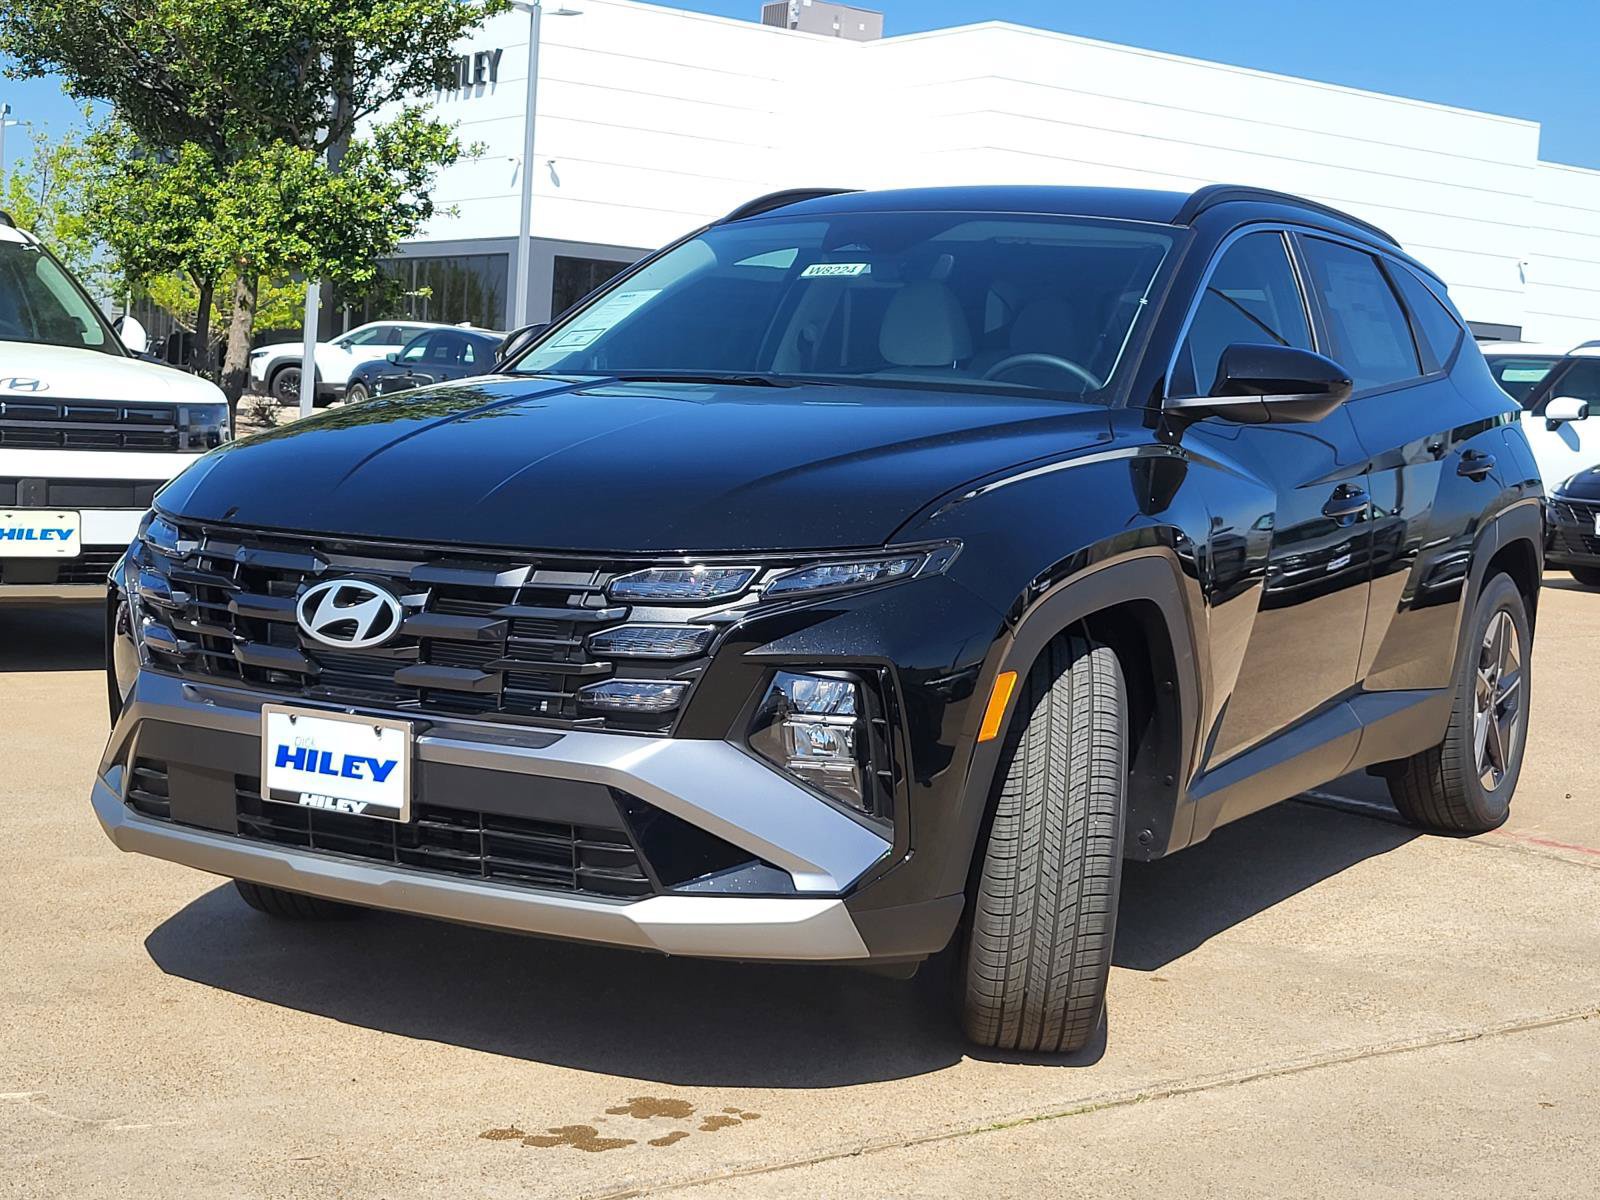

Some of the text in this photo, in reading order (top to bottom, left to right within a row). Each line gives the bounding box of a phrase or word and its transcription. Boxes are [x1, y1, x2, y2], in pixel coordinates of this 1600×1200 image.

[808, 265, 858, 275] W8224
[0, 528, 75, 540] HILEY
[275, 744, 398, 782] HILEY
[299, 792, 368, 813] HILEY
